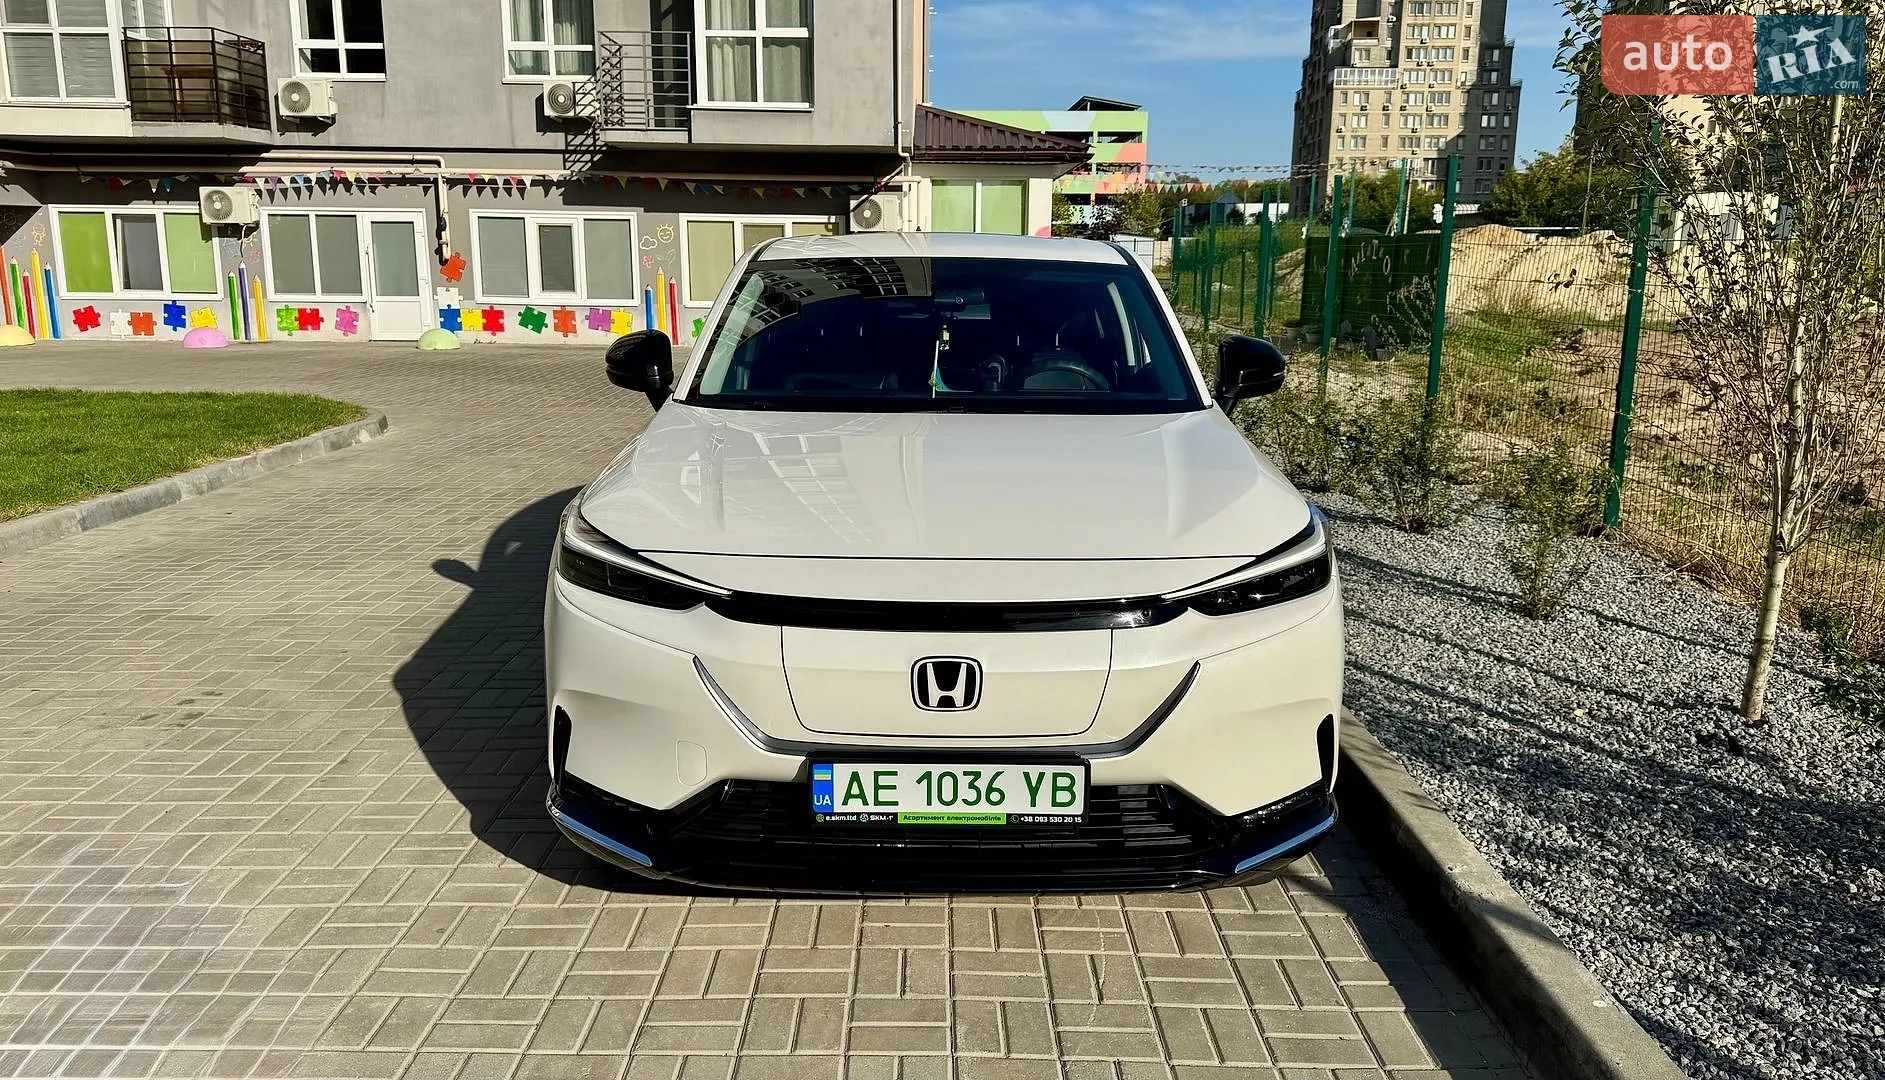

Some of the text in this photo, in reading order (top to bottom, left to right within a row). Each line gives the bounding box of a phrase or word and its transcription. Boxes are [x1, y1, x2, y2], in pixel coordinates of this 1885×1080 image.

[814, 794, 832, 806] UA
[841, 770, 1077, 808] AE 1036 YB
